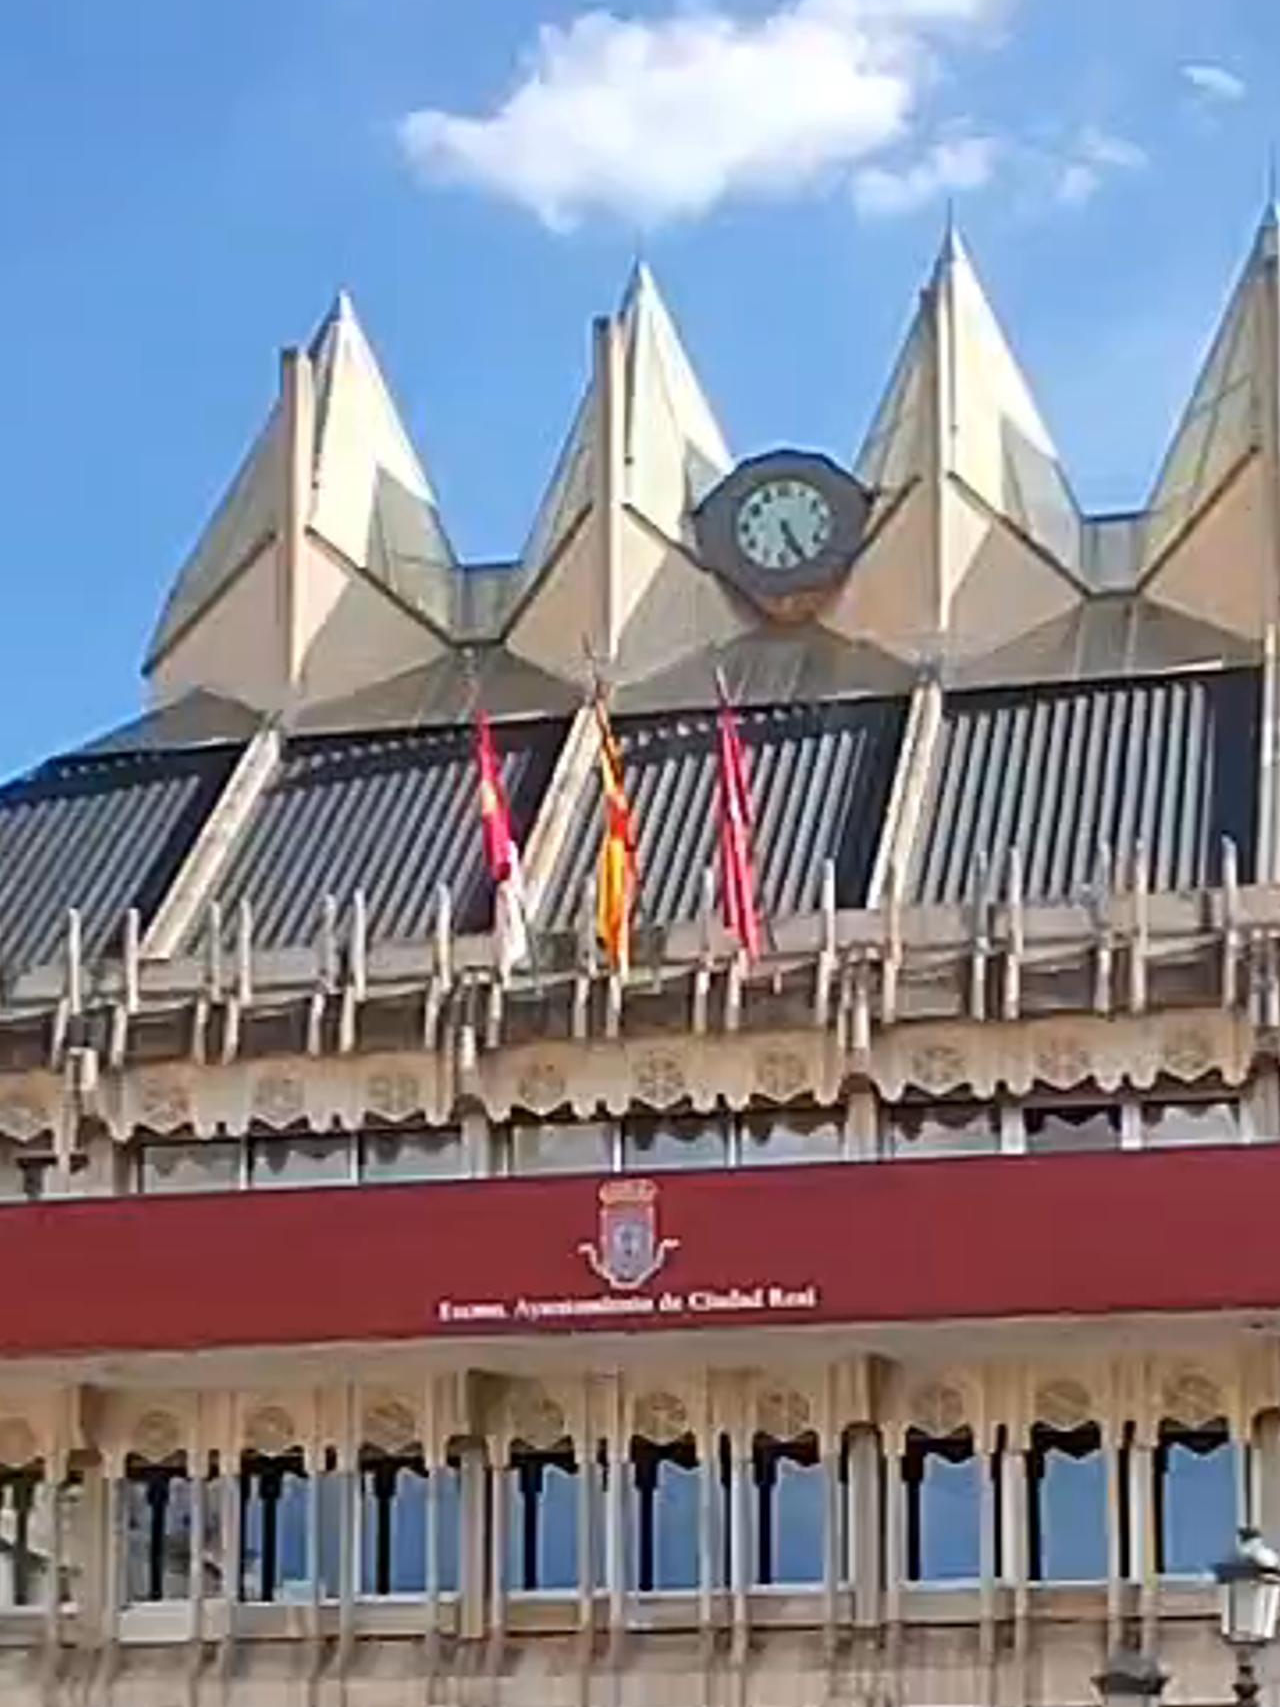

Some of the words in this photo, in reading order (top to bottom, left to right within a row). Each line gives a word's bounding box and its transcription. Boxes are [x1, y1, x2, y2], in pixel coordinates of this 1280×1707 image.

[514, 1296, 654, 1319] Ayuntamiento
[659, 1291, 682, 1312] de
[687, 1288, 764, 1310] Ciudad
[769, 1286, 816, 1308] Real
